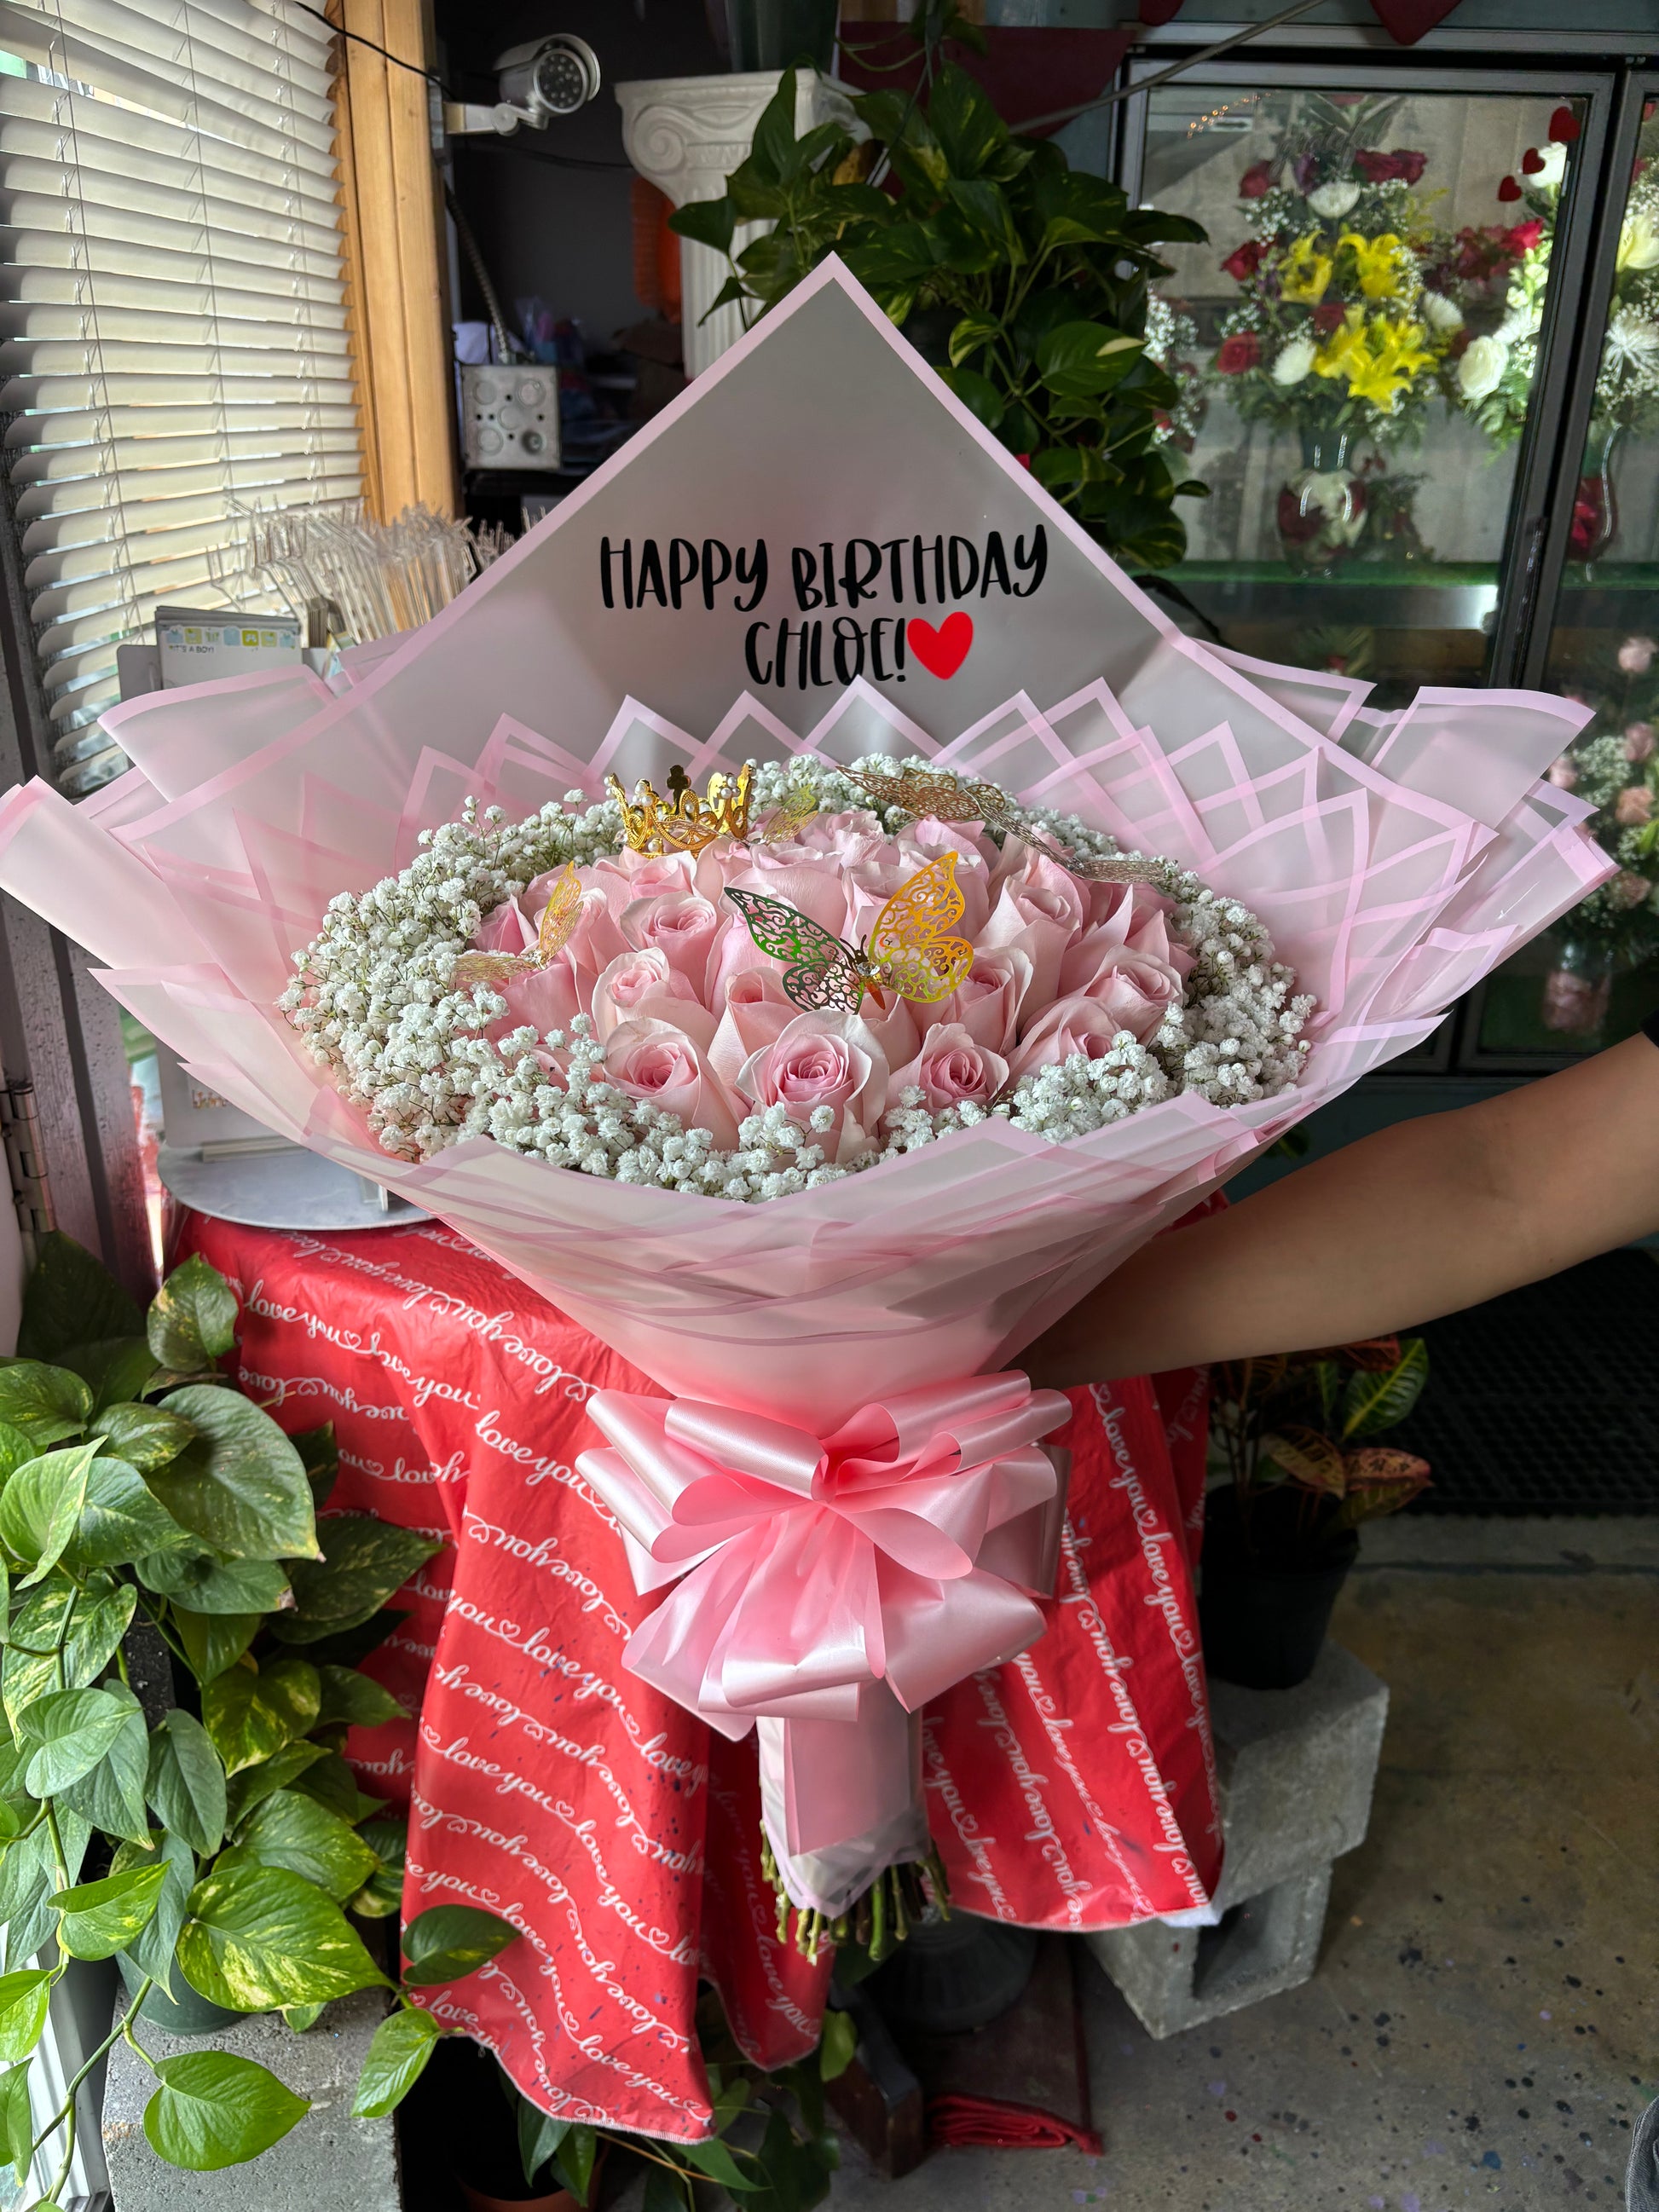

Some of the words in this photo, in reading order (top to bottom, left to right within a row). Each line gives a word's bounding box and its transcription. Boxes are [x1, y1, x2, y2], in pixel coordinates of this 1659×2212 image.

[600, 536, 768, 612] HAPPY
[791, 523, 1049, 612] BIRTHDAY
[744, 616, 906, 690] CHLOE!
